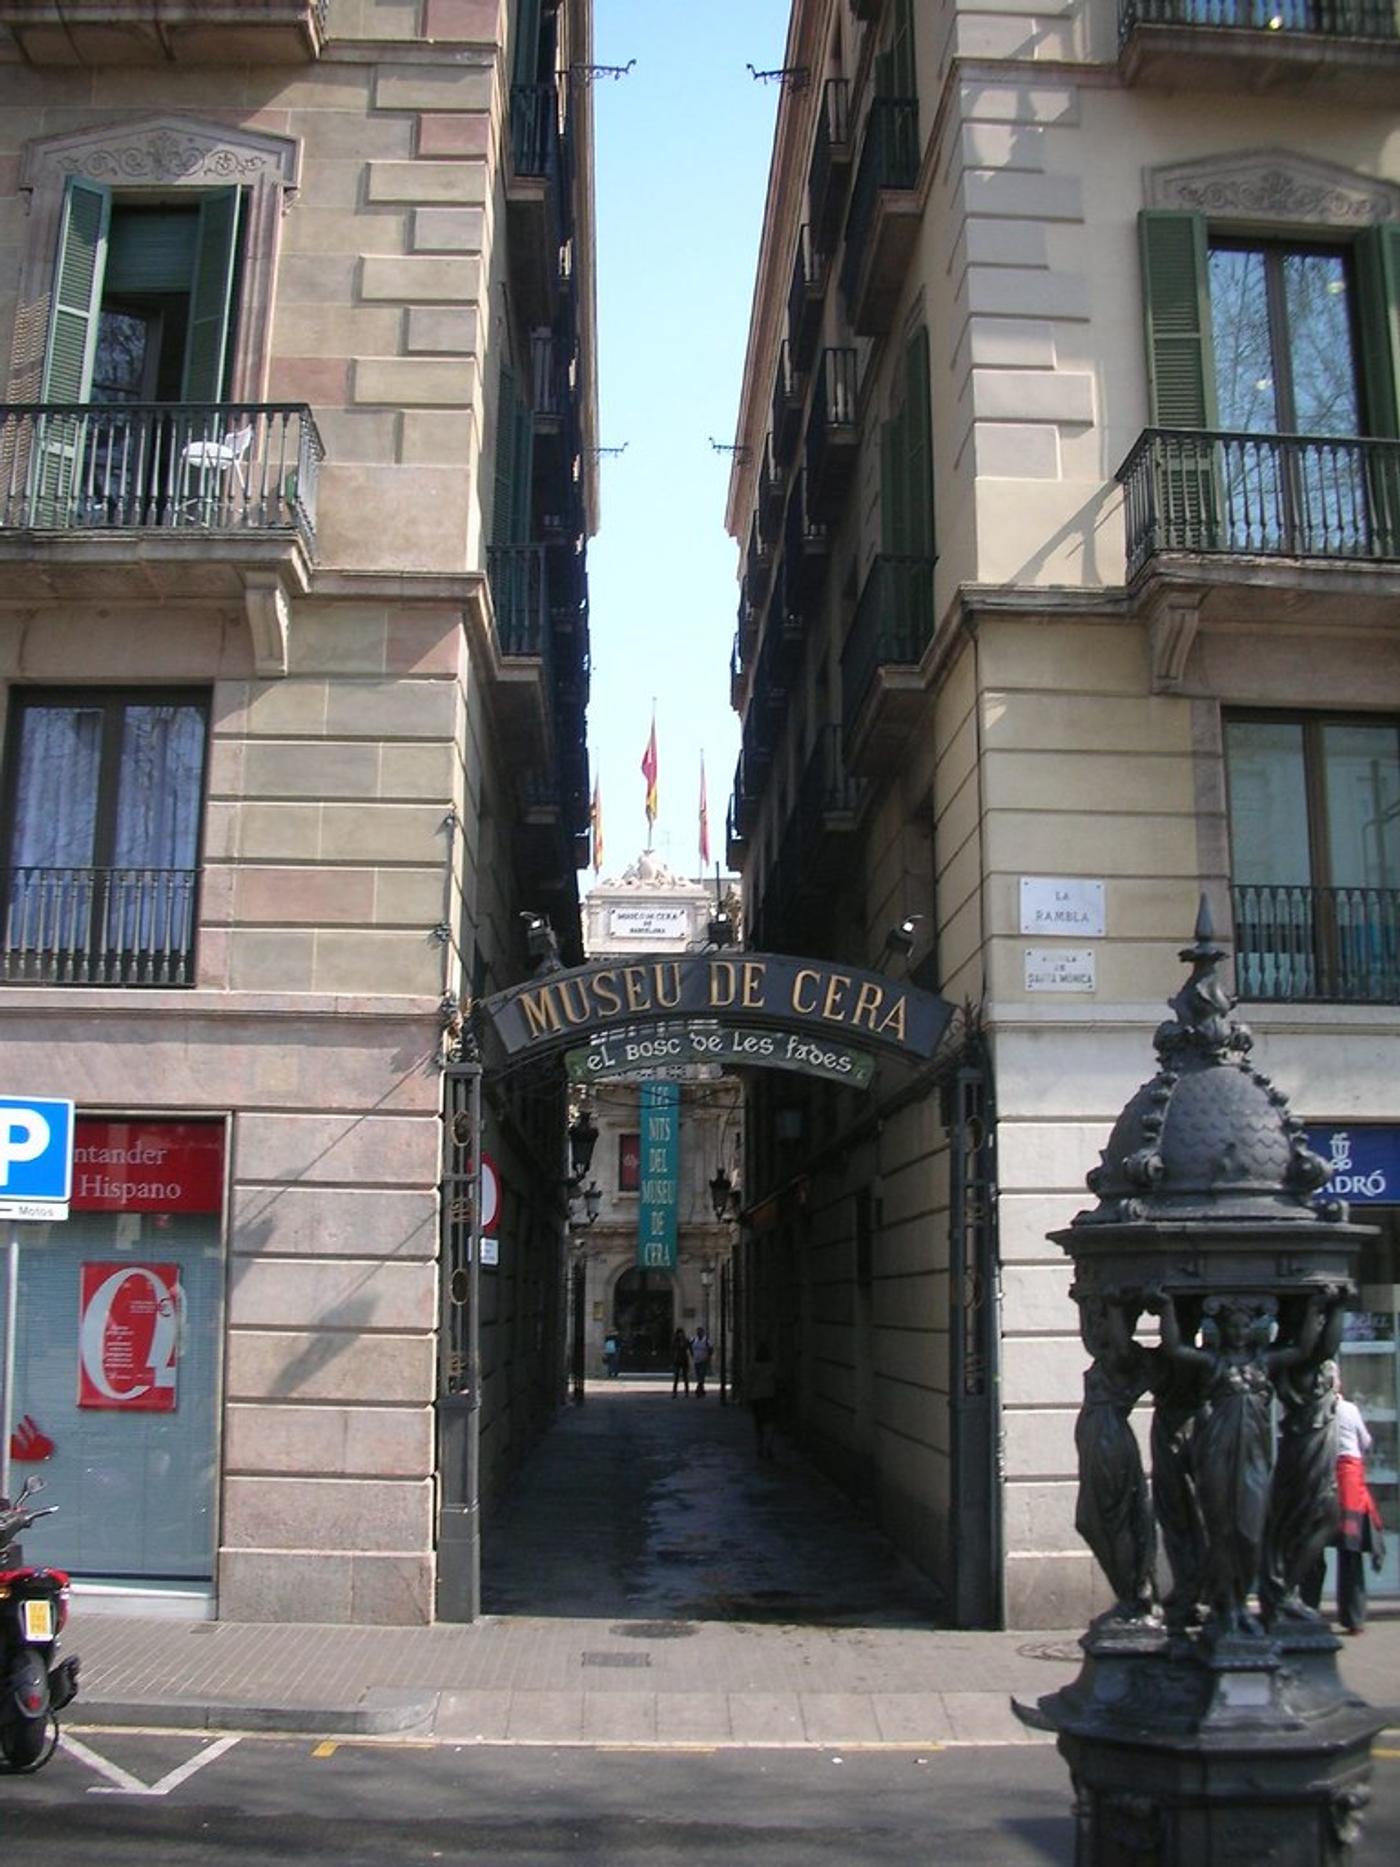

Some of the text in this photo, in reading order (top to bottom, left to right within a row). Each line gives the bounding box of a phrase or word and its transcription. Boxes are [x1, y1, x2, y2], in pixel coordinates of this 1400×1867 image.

[1055, 891, 1070, 901] LA
[1035, 910, 1090, 922] RAMBLA
[519, 961, 906, 1041] MUSEU DE CERA
[648, 1117, 671, 1141] NITS
[0, 1108, 50, 1186] P
[74, 1140, 167, 1165] ntander
[648, 1148, 668, 1172] DEL
[79, 1174, 182, 1204] Hispano
[641, 1180, 673, 1204] MUSEU
[1313, 1169, 1386, 1197] ADRÓ
[18, 1206, 54, 1216] Motos
[651, 1211, 665, 1235] DE
[645, 1243, 671, 1266] CERA
